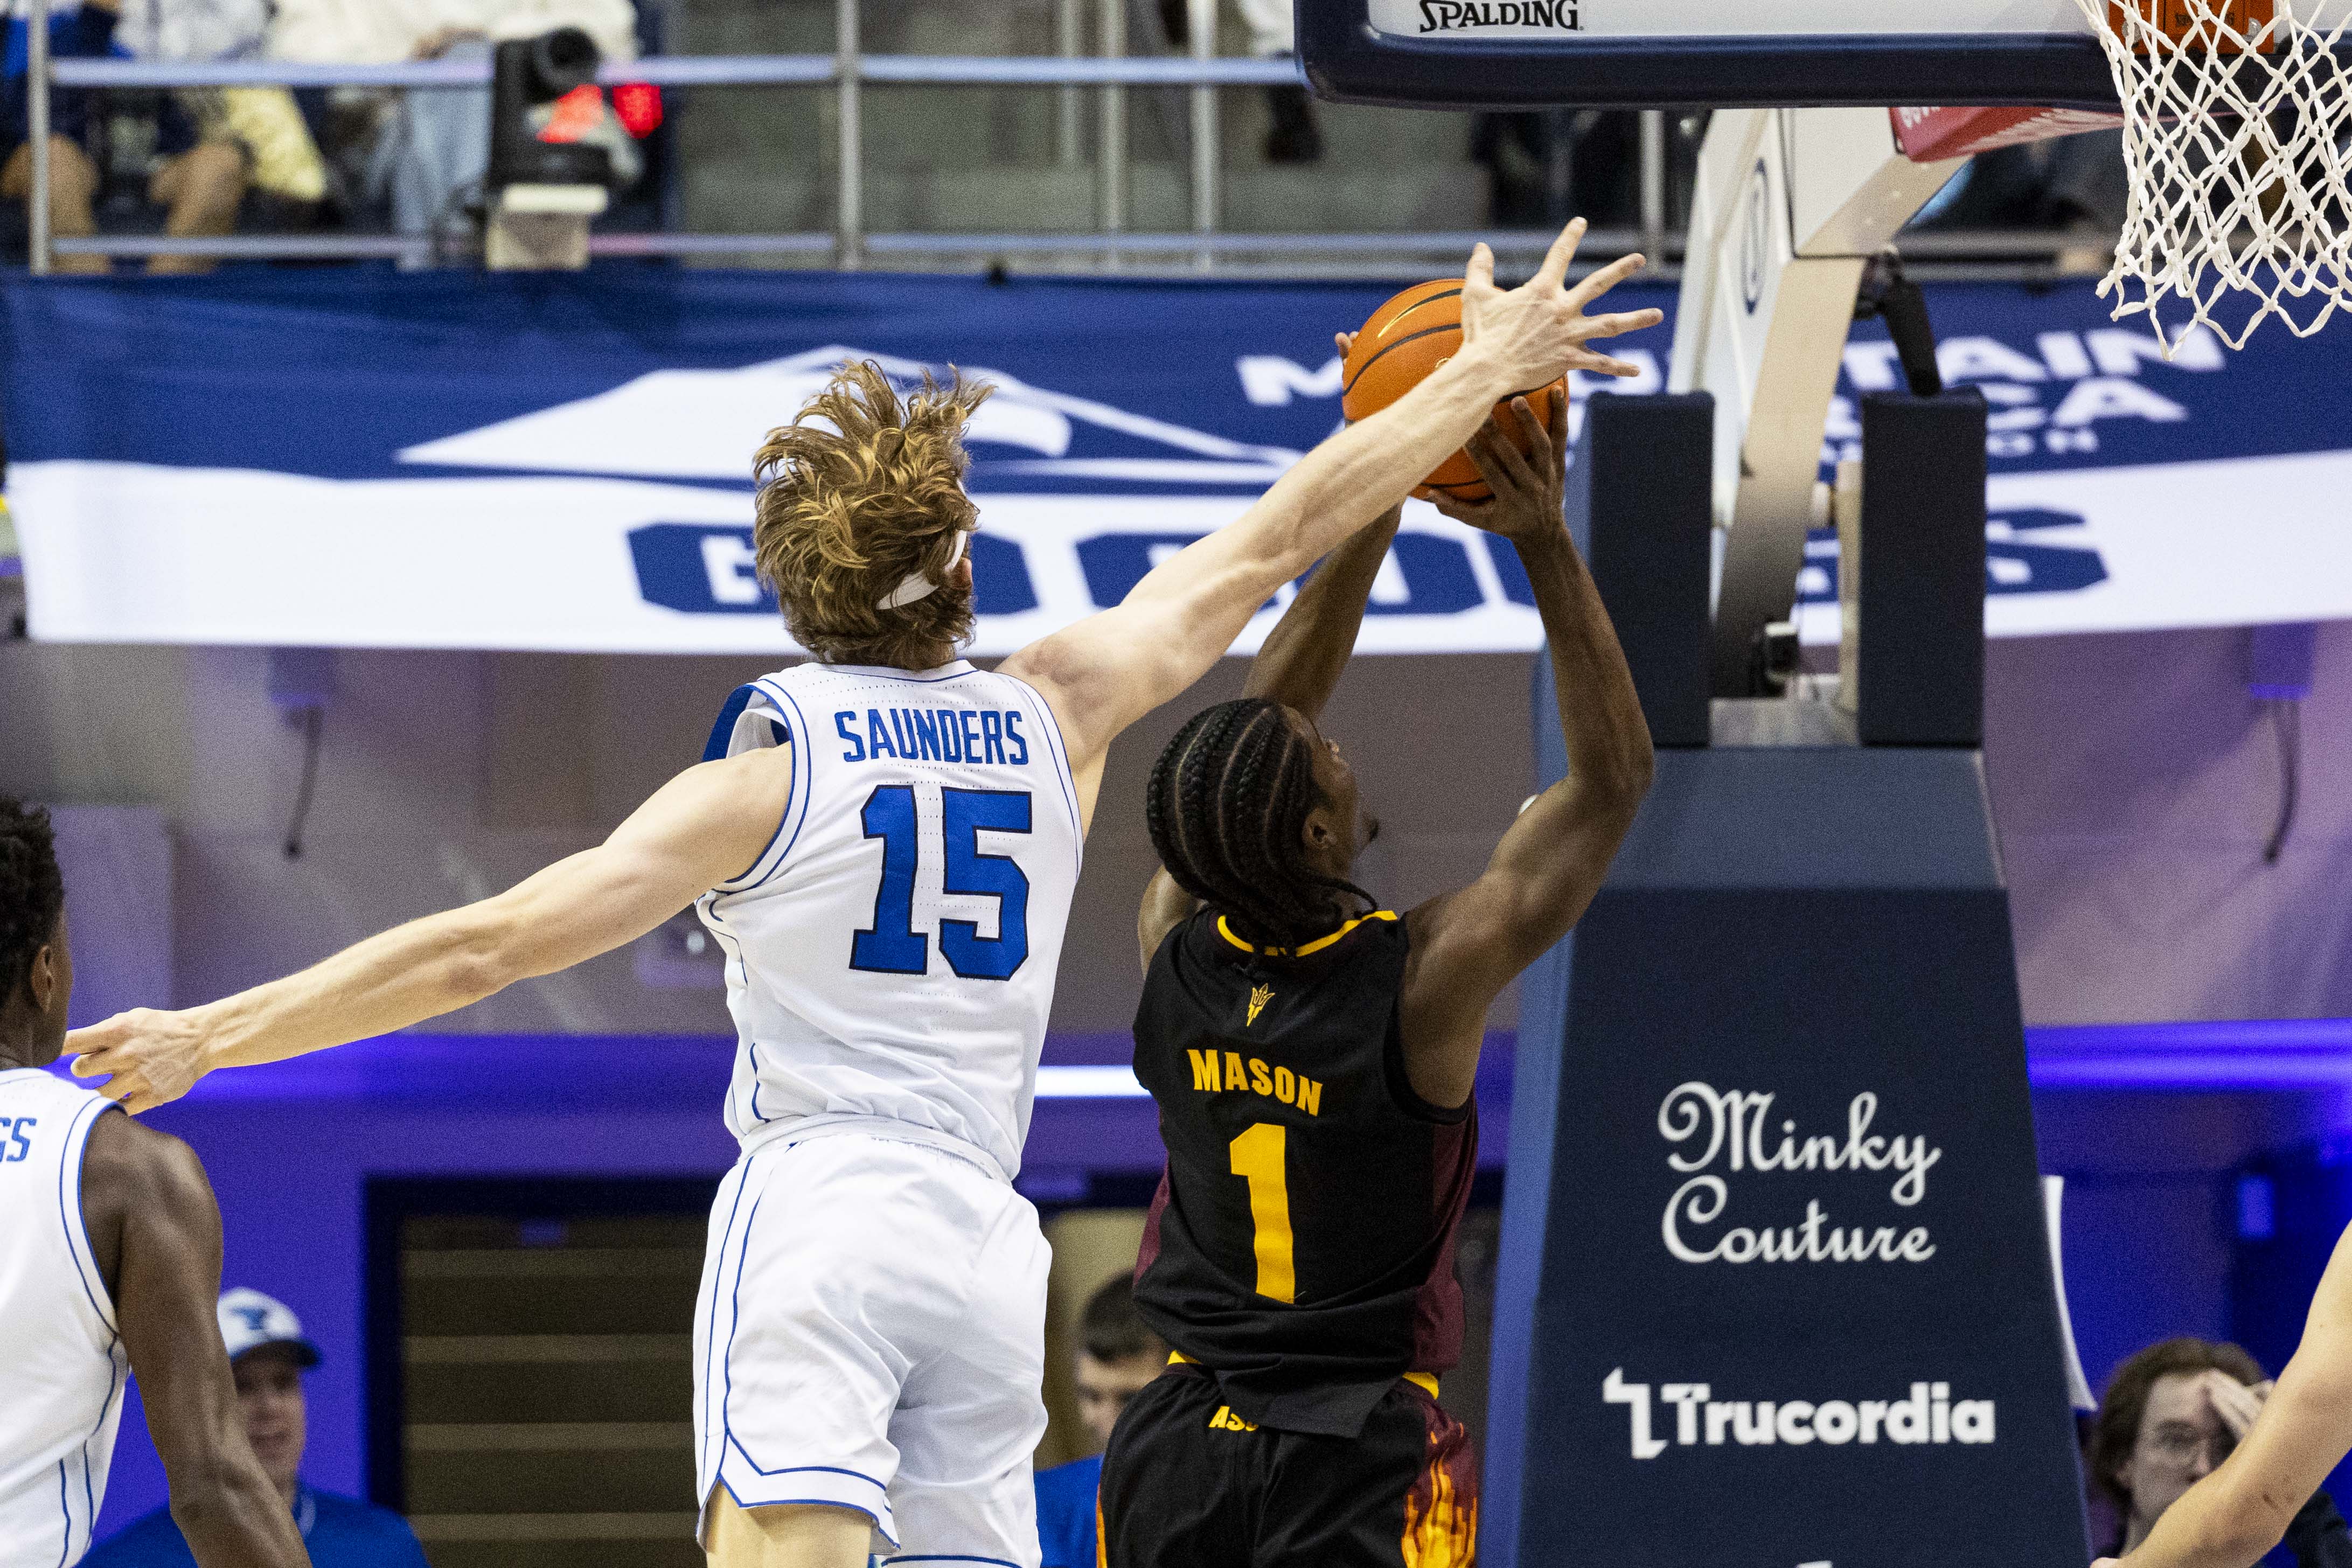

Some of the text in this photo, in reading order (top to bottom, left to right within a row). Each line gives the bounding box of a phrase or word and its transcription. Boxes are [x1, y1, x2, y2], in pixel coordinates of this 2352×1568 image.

[1419, 0, 1579, 32] SPALDING
[834, 708, 1029, 765] SAUNDERS
[849, 784, 1032, 981] 15
[1187, 1049, 1323, 1117] MASON
[1658, 1081, 1942, 1205] Minky
[1229, 1123, 1295, 1305] 1
[1661, 1175, 1937, 1263] Couture
[1660, 1382, 1996, 1445] Trucordia
